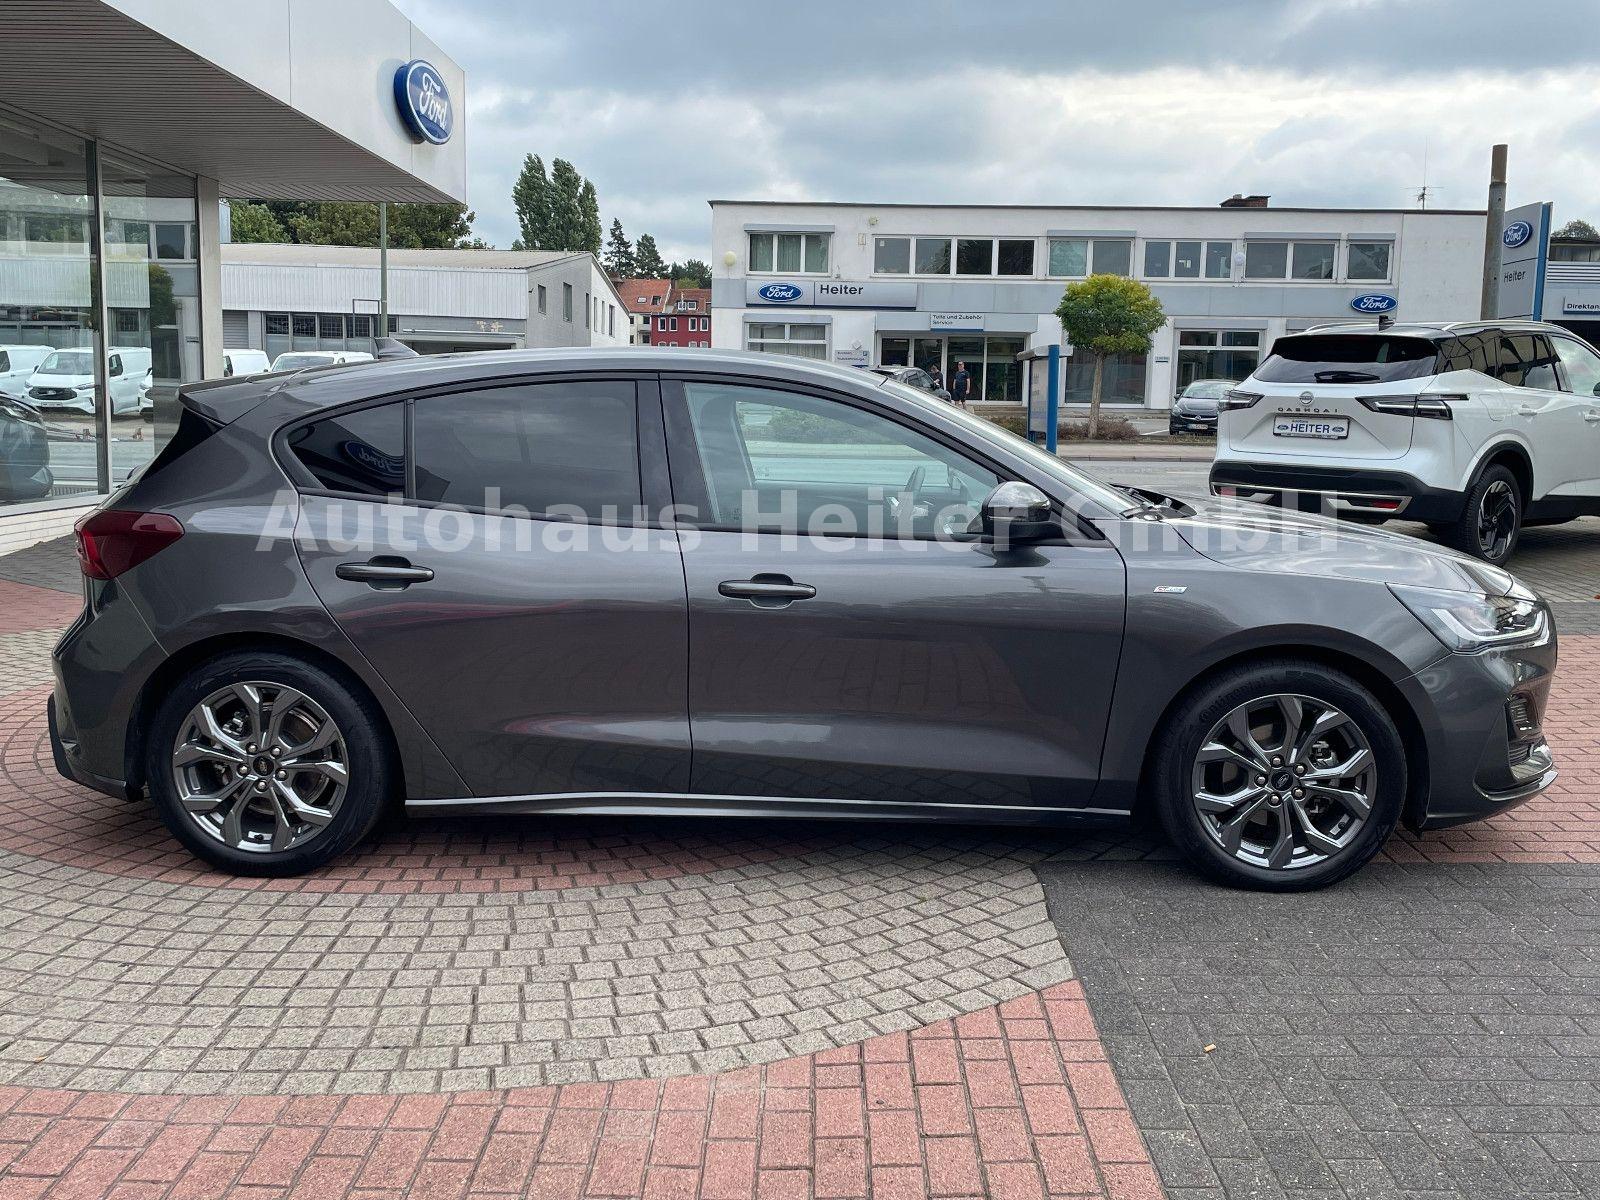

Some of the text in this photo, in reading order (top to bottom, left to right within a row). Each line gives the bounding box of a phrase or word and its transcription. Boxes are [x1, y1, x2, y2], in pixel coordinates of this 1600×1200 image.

[419, 72, 448, 130] Ford
[1503, 270, 1527, 283] Heiter
[820, 284, 864, 295] Heiter
[1290, 423, 1330, 434] HEITER
